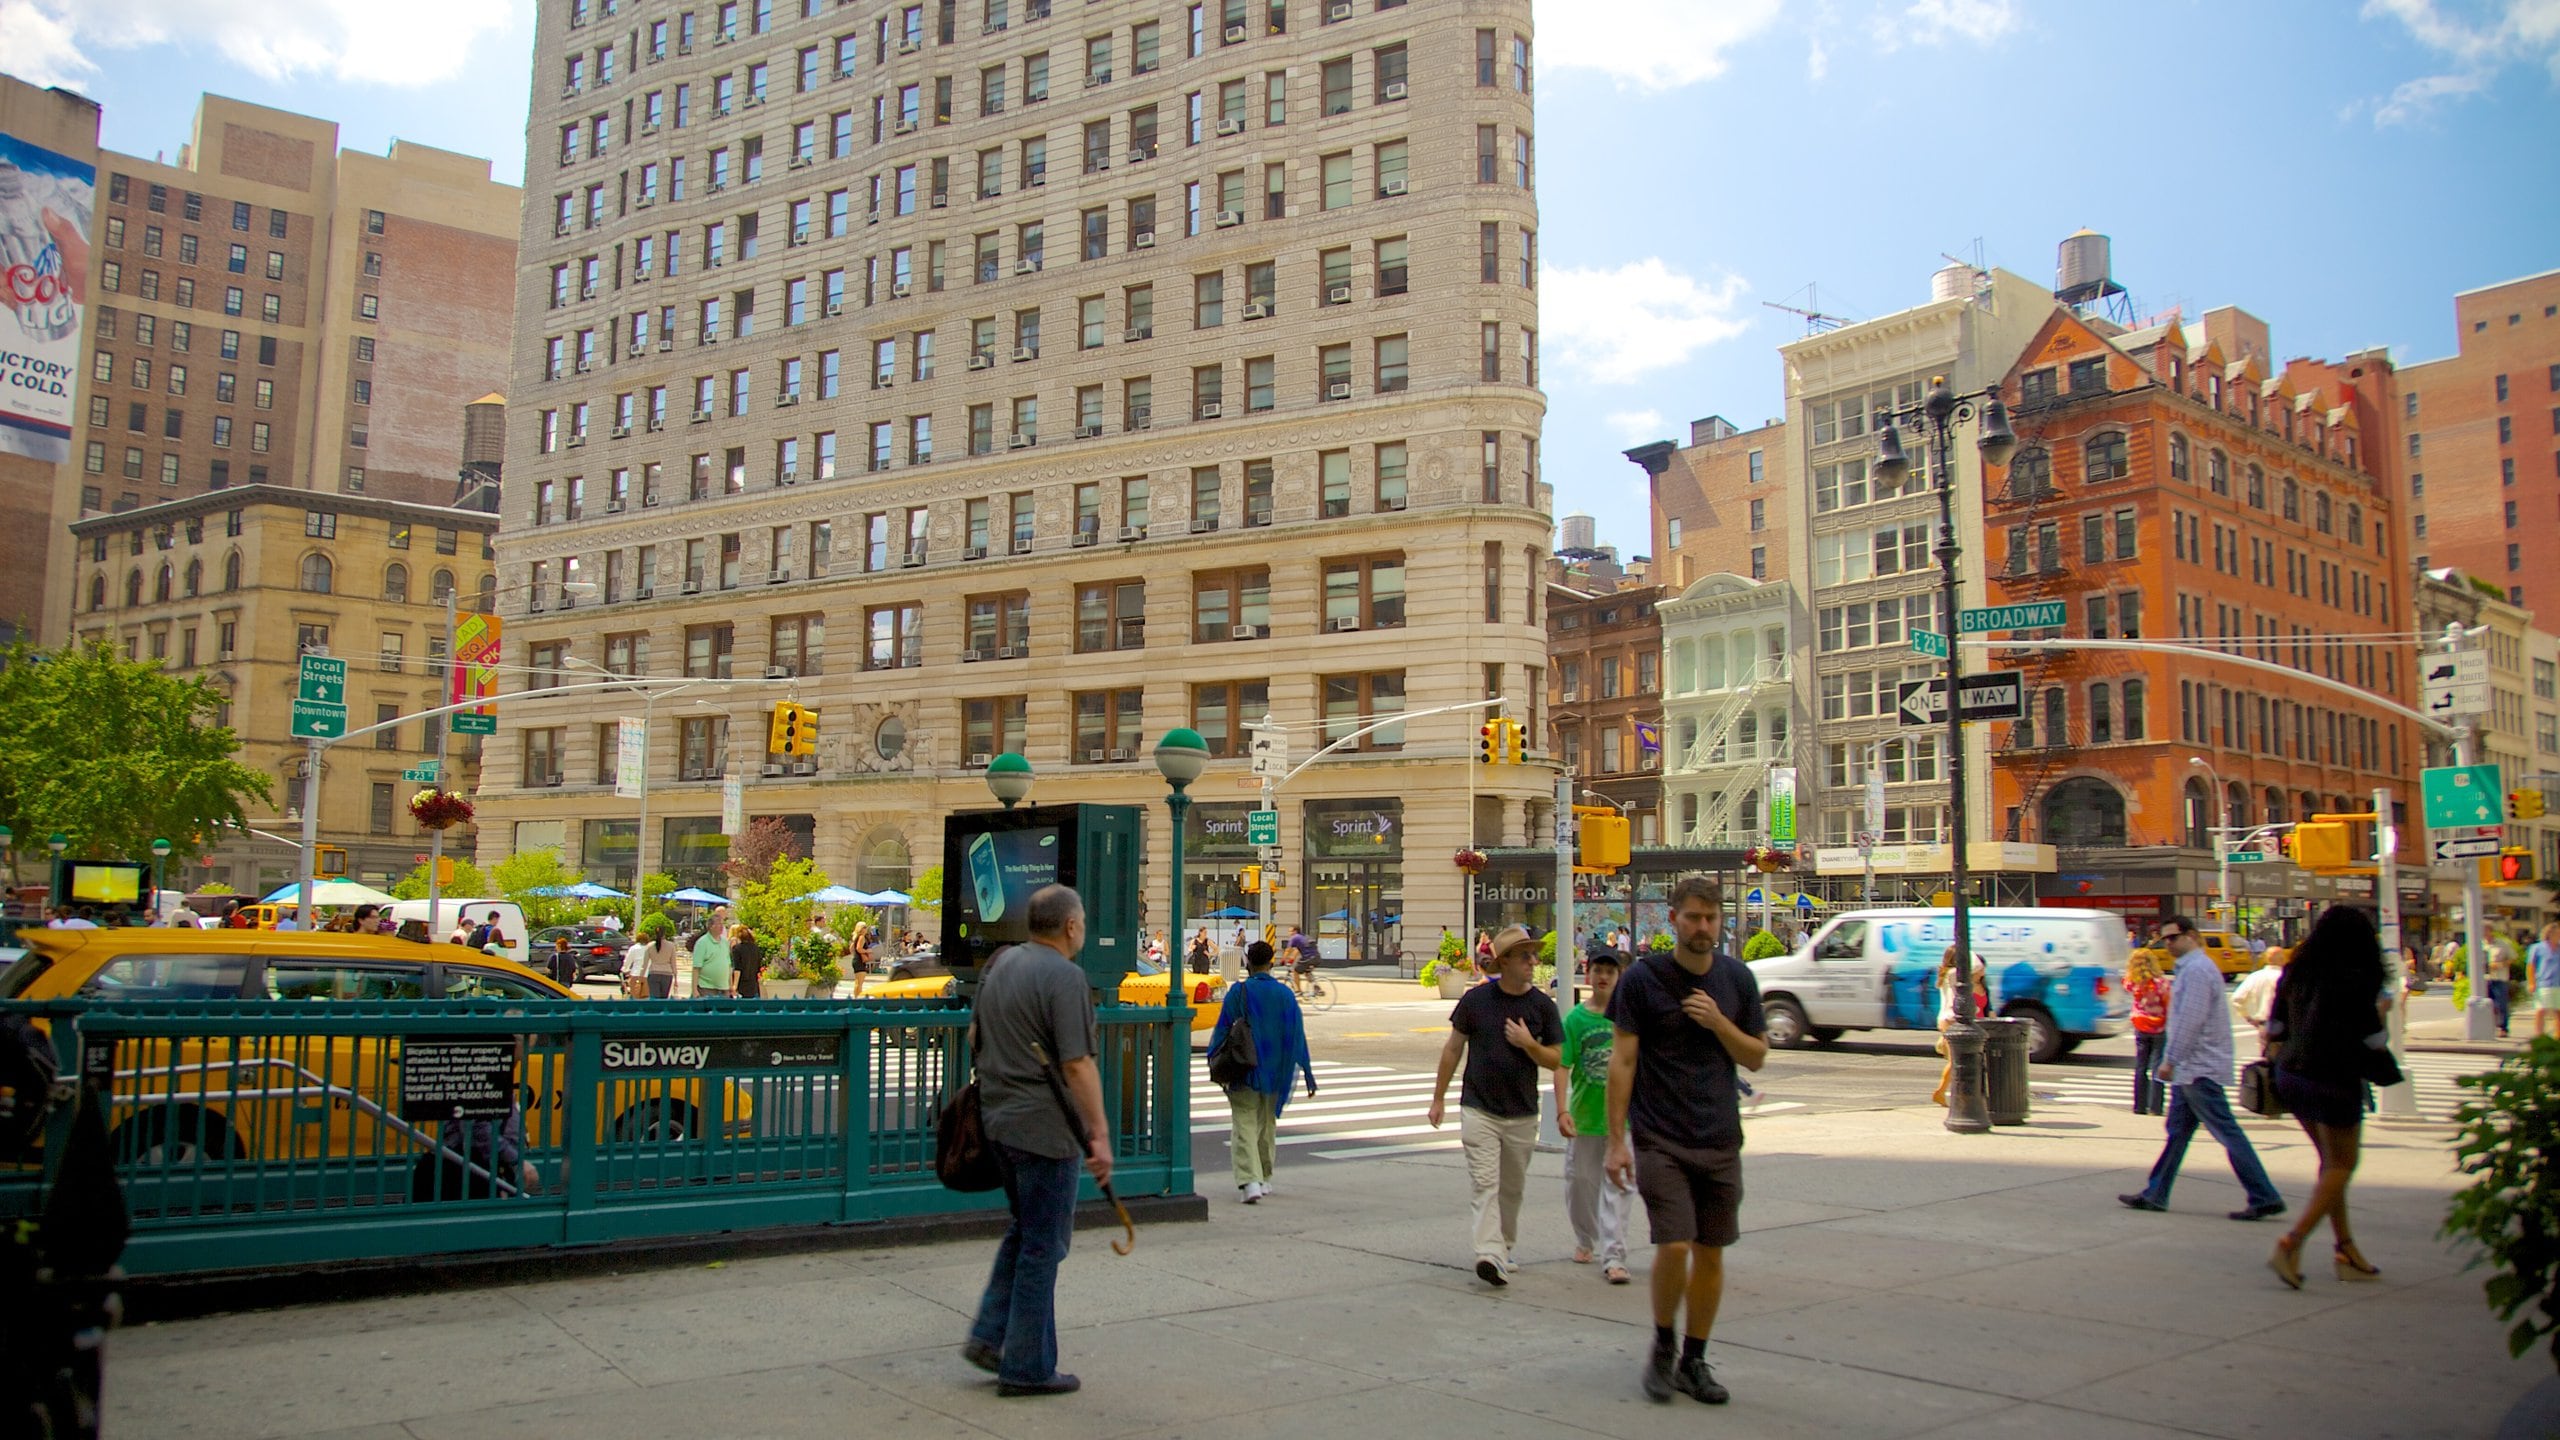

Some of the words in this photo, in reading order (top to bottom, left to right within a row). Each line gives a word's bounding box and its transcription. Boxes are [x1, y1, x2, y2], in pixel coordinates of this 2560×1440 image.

[0, 349, 73, 380] ICTORY
[11, 371, 68, 398] COLD.
[1963, 605, 2061, 631] BROADWAY
[1914, 632, 1920, 651] E
[1923, 634, 1936, 654] 23
[306, 659, 341, 673] Local
[303, 671, 343, 684] Streets
[1909, 693, 1942, 711] ONE
[1971, 688, 2009, 705] WAY
[295, 705, 346, 718] Downtown
[414, 771, 425, 780] 23
[1252, 814, 1274, 822] Local
[1205, 819, 1243, 837] Sprint
[1251, 823, 1276, 832] Streets
[1332, 819, 1373, 837] Sprint
[1474, 882, 1549, 901] Flatiron
[1977, 923, 2036, 943] CHIP
[406, 1047, 438, 1056] Bicycles
[449, 1047, 469, 1055] other
[471, 1046, 502, 1056] property
[604, 1042, 710, 1069] Subway
[406, 1056, 440, 1065] attached
[441, 1056, 449, 1064] to
[451, 1056, 472, 1064] these
[473, 1056, 499, 1065] railings
[405, 1066, 416, 1074] be
[418, 1065, 451, 1073] removed
[452, 1065, 466, 1073] and
[467, 1064, 501, 1073] delivered
[405, 1075, 418, 1083] the
[420, 1074, 437, 1082] Lost
[439, 1074, 471, 1083] Property
[405, 1084, 434, 1092] located
[435, 1083, 443, 1091] at
[445, 1083, 456, 1091] 34
[484, 1082, 494, 1090] Av
